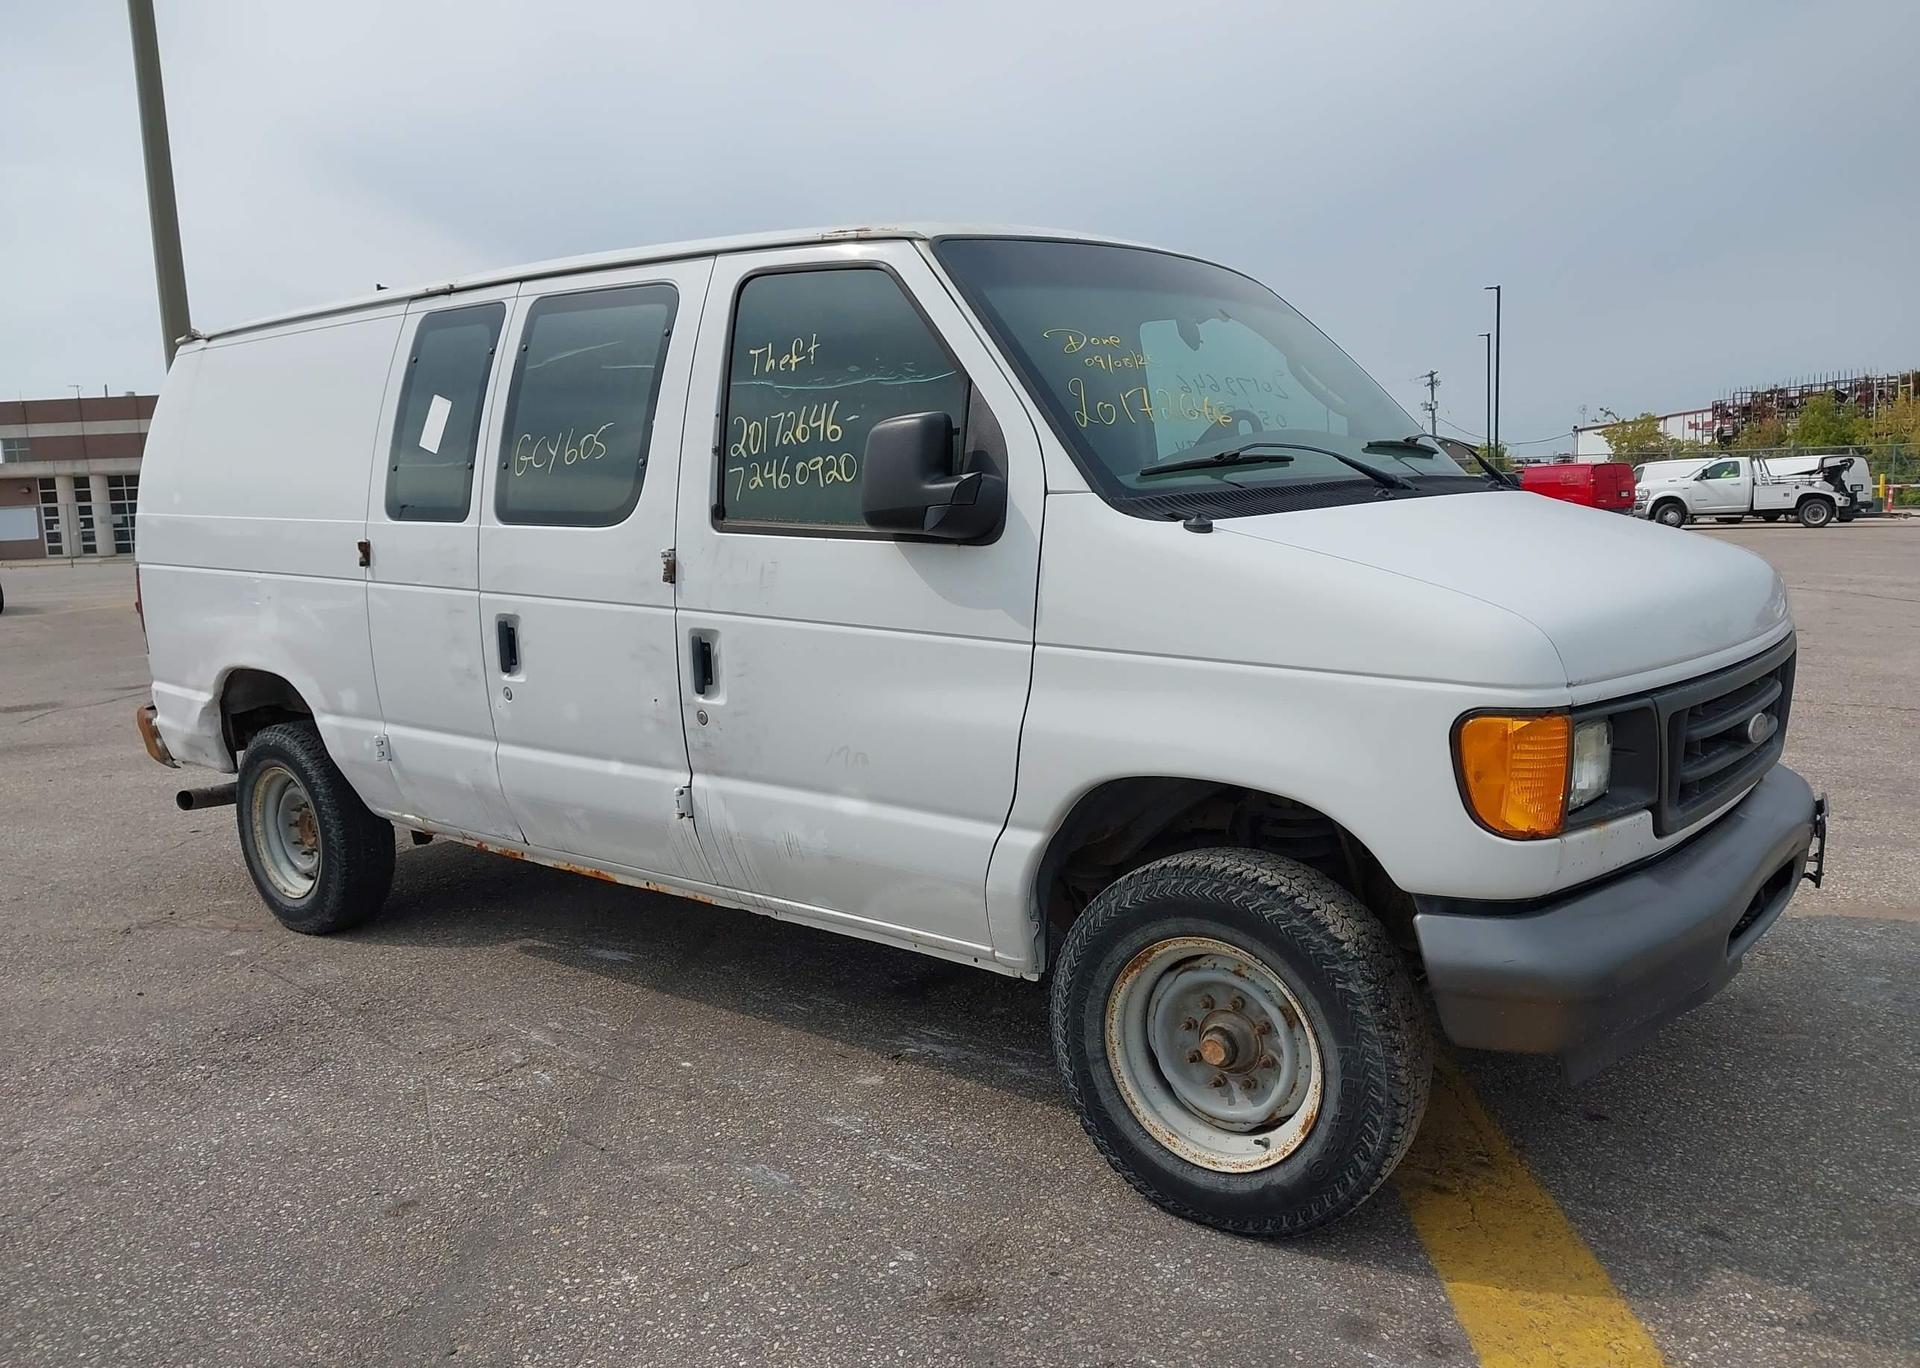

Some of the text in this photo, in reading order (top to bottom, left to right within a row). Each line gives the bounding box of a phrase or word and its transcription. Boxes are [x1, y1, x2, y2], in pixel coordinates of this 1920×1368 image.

[749, 333, 821, 376] Theft
[1043, 328, 1121, 354] Done
[728, 452, 858, 501] 72460920
